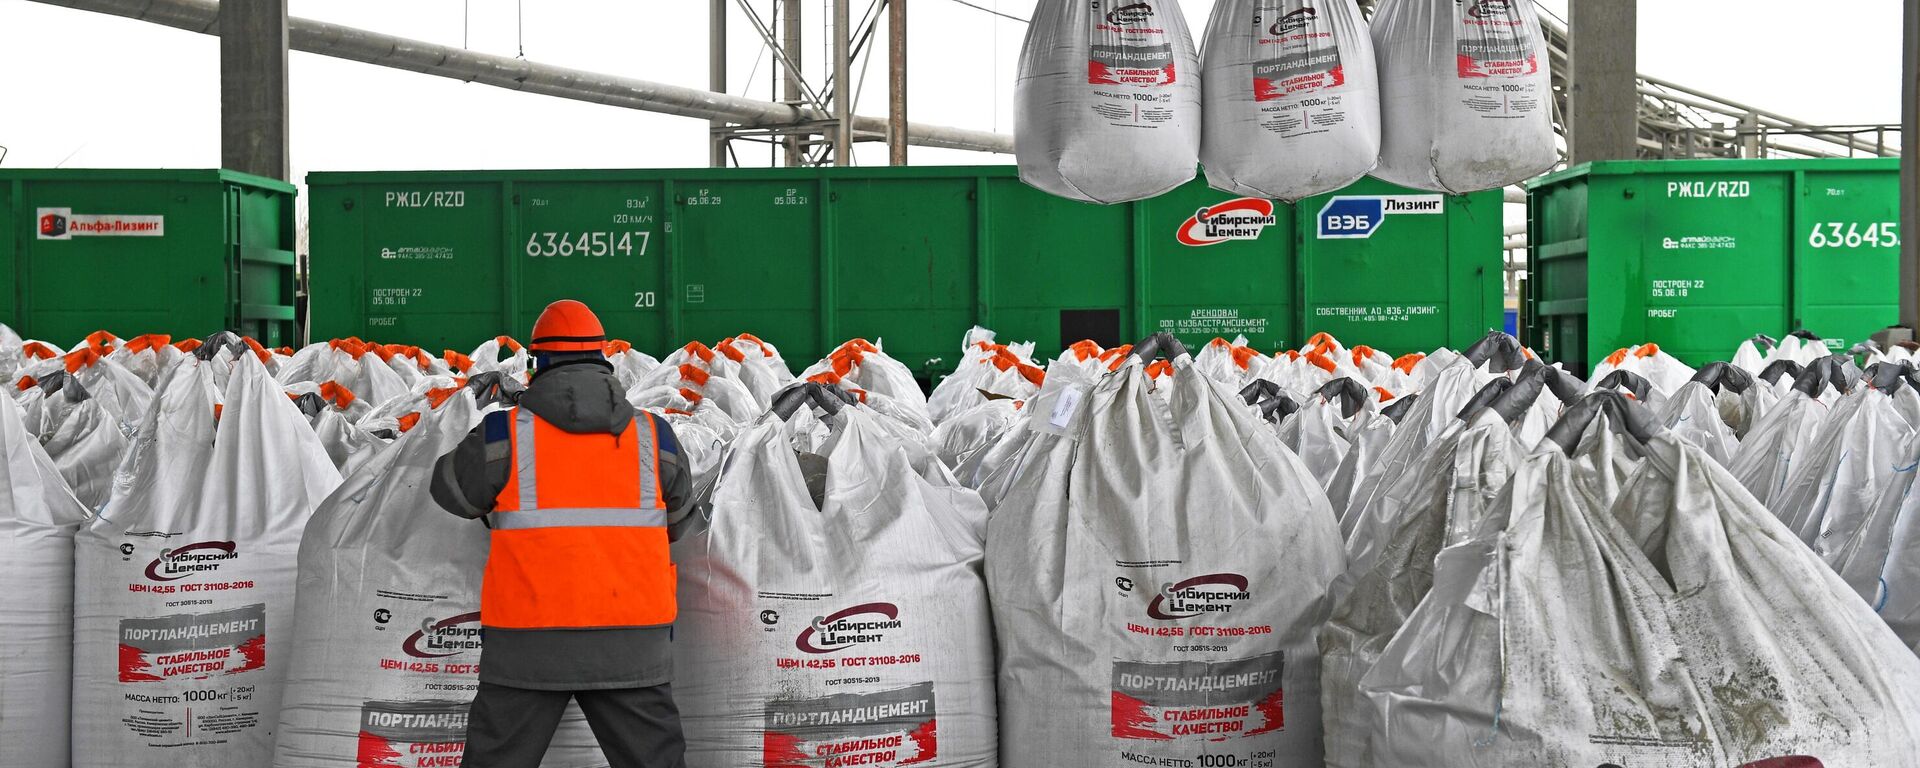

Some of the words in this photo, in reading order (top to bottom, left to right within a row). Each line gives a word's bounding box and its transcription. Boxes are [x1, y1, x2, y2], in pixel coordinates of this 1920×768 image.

[1093, 50, 1171, 61] ПОРТЛАНДЦЕМЕНТ
[1257, 54, 1338, 75] ПОРТЛАНДЦЕМЕНТ
[1116, 69, 1160, 77] СТАБИЛЬНОЕ
[1119, 76, 1157, 84] КАЧЕСТВО!
[1281, 73, 1325, 88] СТАБИЛЬНОЕ
[1286, 81, 1323, 94] КАЧЕСТВО!
[1501, 84, 1520, 93] 1000
[1093, 90, 1114, 99] МАССА
[1133, 93, 1152, 102] 1000
[1261, 105, 1280, 113] МАССА
[1280, 103, 1298, 111] НЕТТО:
[1300, 98, 1320, 108] 1000
[1668, 181, 1749, 198] РЖД/RZD
[386, 191, 465, 207] РЖД/RZD
[1385, 199, 1440, 211] Лизинг
[613, 214, 628, 224] 120
[1197, 208, 1274, 228] Сибирский
[1327, 215, 1370, 230] ВЭБ
[70, 220, 159, 233] Альфа-Лизинг
[1206, 225, 1258, 237] Цемент
[1809, 222, 1901, 248] 63645
[526, 231, 650, 257] 63645147
[1653, 280, 1692, 289] ПОСТРОЕН
[1694, 280, 1704, 288] 22
[373, 288, 410, 297] ПОСТРОЕН
[412, 288, 422, 297] 22
[634, 291, 655, 308] 20
[1652, 289, 1688, 297] 05.06.18
[1191, 309, 1238, 319] АРЕНДОВАН
[1316, 307, 1367, 316] СОБСТВЕННИК
[1371, 306, 1382, 315] АО
[1648, 309, 1677, 318] ПРОБЕГ
[369, 317, 397, 326] ПРОБЕГ
[1160, 320, 1174, 328] ООО
[160, 548, 238, 564] Сибирский
[165, 562, 219, 574] Цемент
[129, 583, 147, 593] ЦЕМ
[152, 585, 175, 595] 42,5Б
[180, 584, 201, 593] ГОСТ
[203, 580, 254, 591] 31108-2016
[1161, 582, 1250, 603] Сибирский
[1170, 599, 1232, 613] Цемент
[124, 618, 258, 641] ПОРТЛАНДЦЕМЕНТ
[812, 615, 901, 633] Сибирский
[1127, 622, 1149, 636] ЦЕМ
[1156, 626, 1184, 638] 42,5Б
[1189, 626, 1215, 637] ГОСТ
[1217, 624, 1272, 637] 31108-2016
[820, 632, 883, 645] Цемент
[1173, 645, 1189, 653] ГОСТ
[1190, 645, 1228, 653] 30515-2013
[157, 649, 230, 666] СТАБИЛЬНОЕ
[777, 657, 799, 670] ЦЕМ
[806, 659, 836, 670] 42,5Б
[841, 656, 867, 667] ГОСТ
[869, 654, 920, 666] 31108-2016
[163, 660, 224, 677] КАЧЕСТВО!
[380, 659, 402, 671] ЦЕМ
[409, 663, 439, 674] 42,5Б
[444, 664, 471, 674] ГОСТ
[425, 683, 442, 691] ГОСТ
[843, 676, 881, 685] 30515-2013
[1120, 669, 1278, 693] ПОРТЛАНДЦЕМЕНТ
[125, 693, 151, 704] МАССА
[152, 695, 180, 704] НЕТТО:
[183, 690, 216, 702] 1000
[217, 692, 228, 701] кг
[773, 699, 929, 726] ПОРТЛАНДЦЕМЕНТ
[1164, 705, 1249, 722] СТАБИЛЬНОЕ
[1172, 720, 1243, 736] КАЧЕСТВО!
[816, 735, 902, 756] СТАБИЛЬНОЕ
[824, 750, 896, 768] КАЧЕСТВО!
[1121, 751, 1156, 766] МАССА
[1159, 757, 1194, 768] НЕТТО:
[1197, 754, 1235, 768] 1000
[1237, 759, 1249, 767] кг
